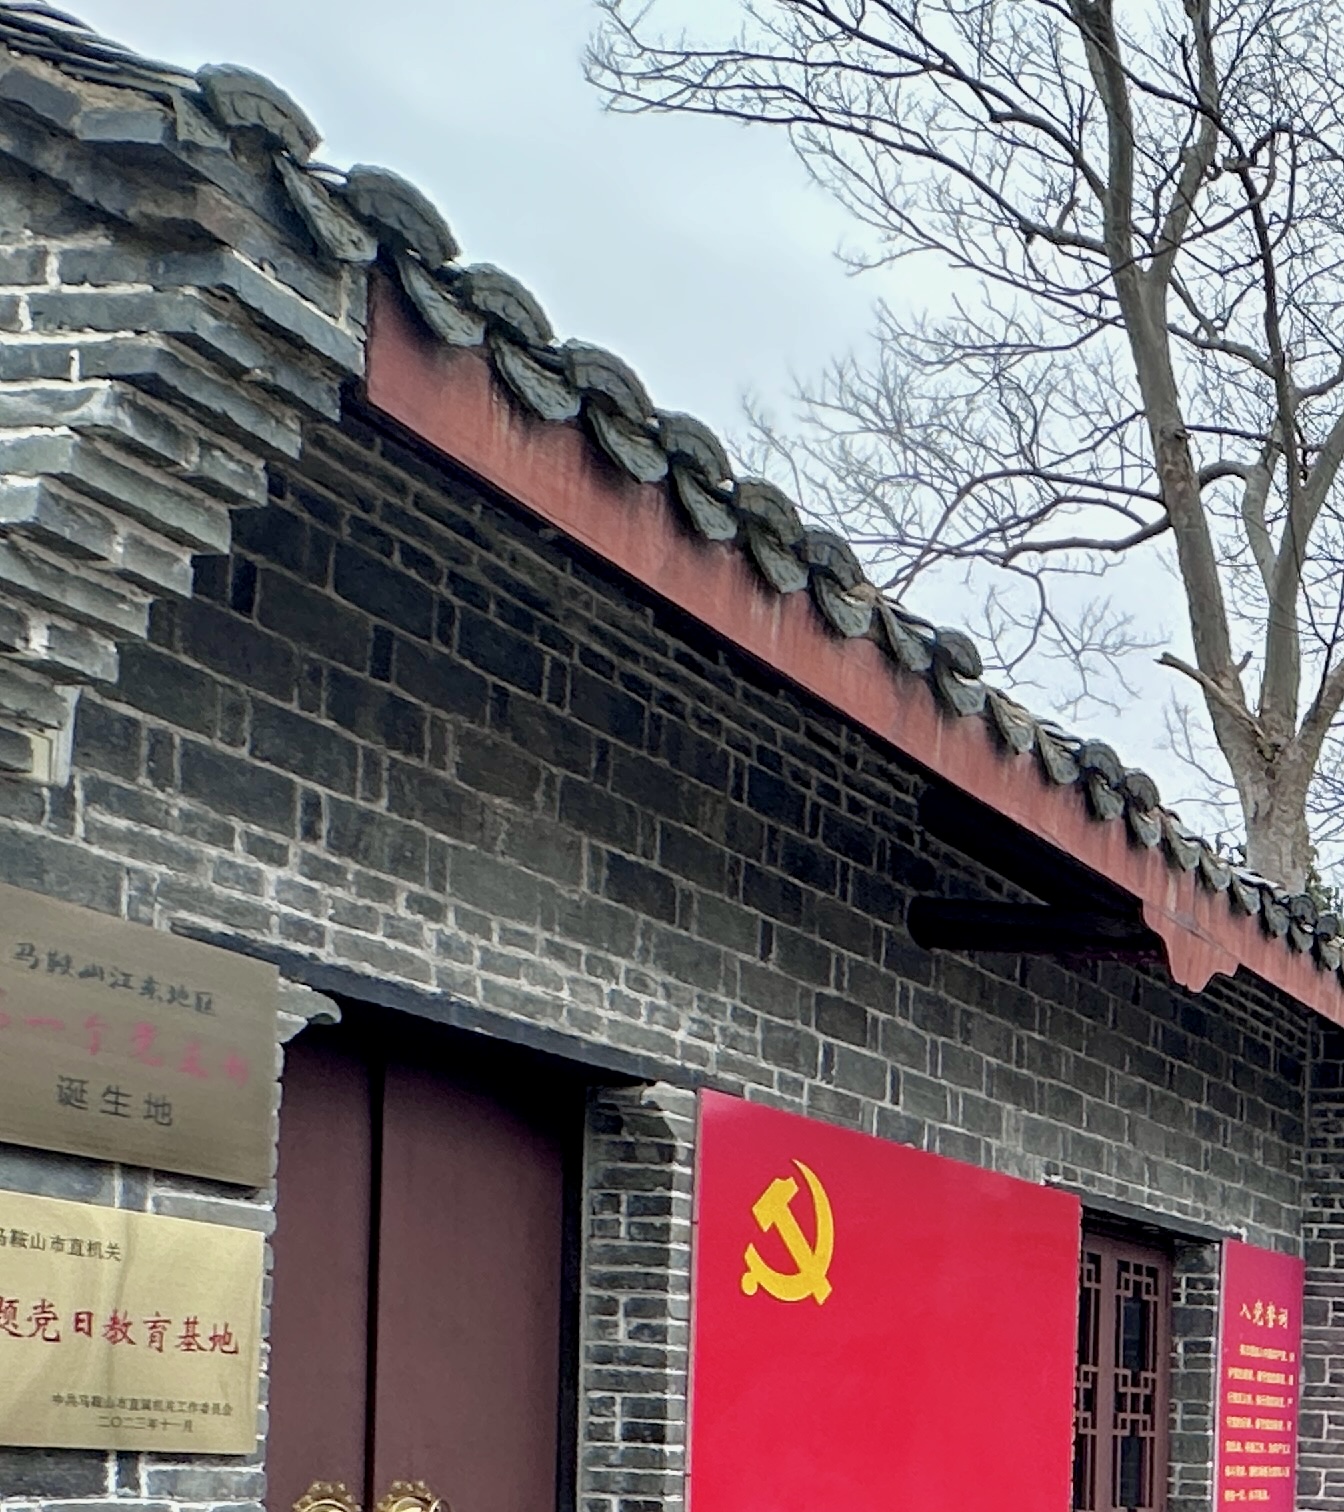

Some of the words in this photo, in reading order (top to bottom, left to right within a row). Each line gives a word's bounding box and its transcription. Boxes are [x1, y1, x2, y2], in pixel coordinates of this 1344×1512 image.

[13, 941, 216, 1017] 马鞍山江东地区
[56, 1074, 173, 1127] 诞生地
